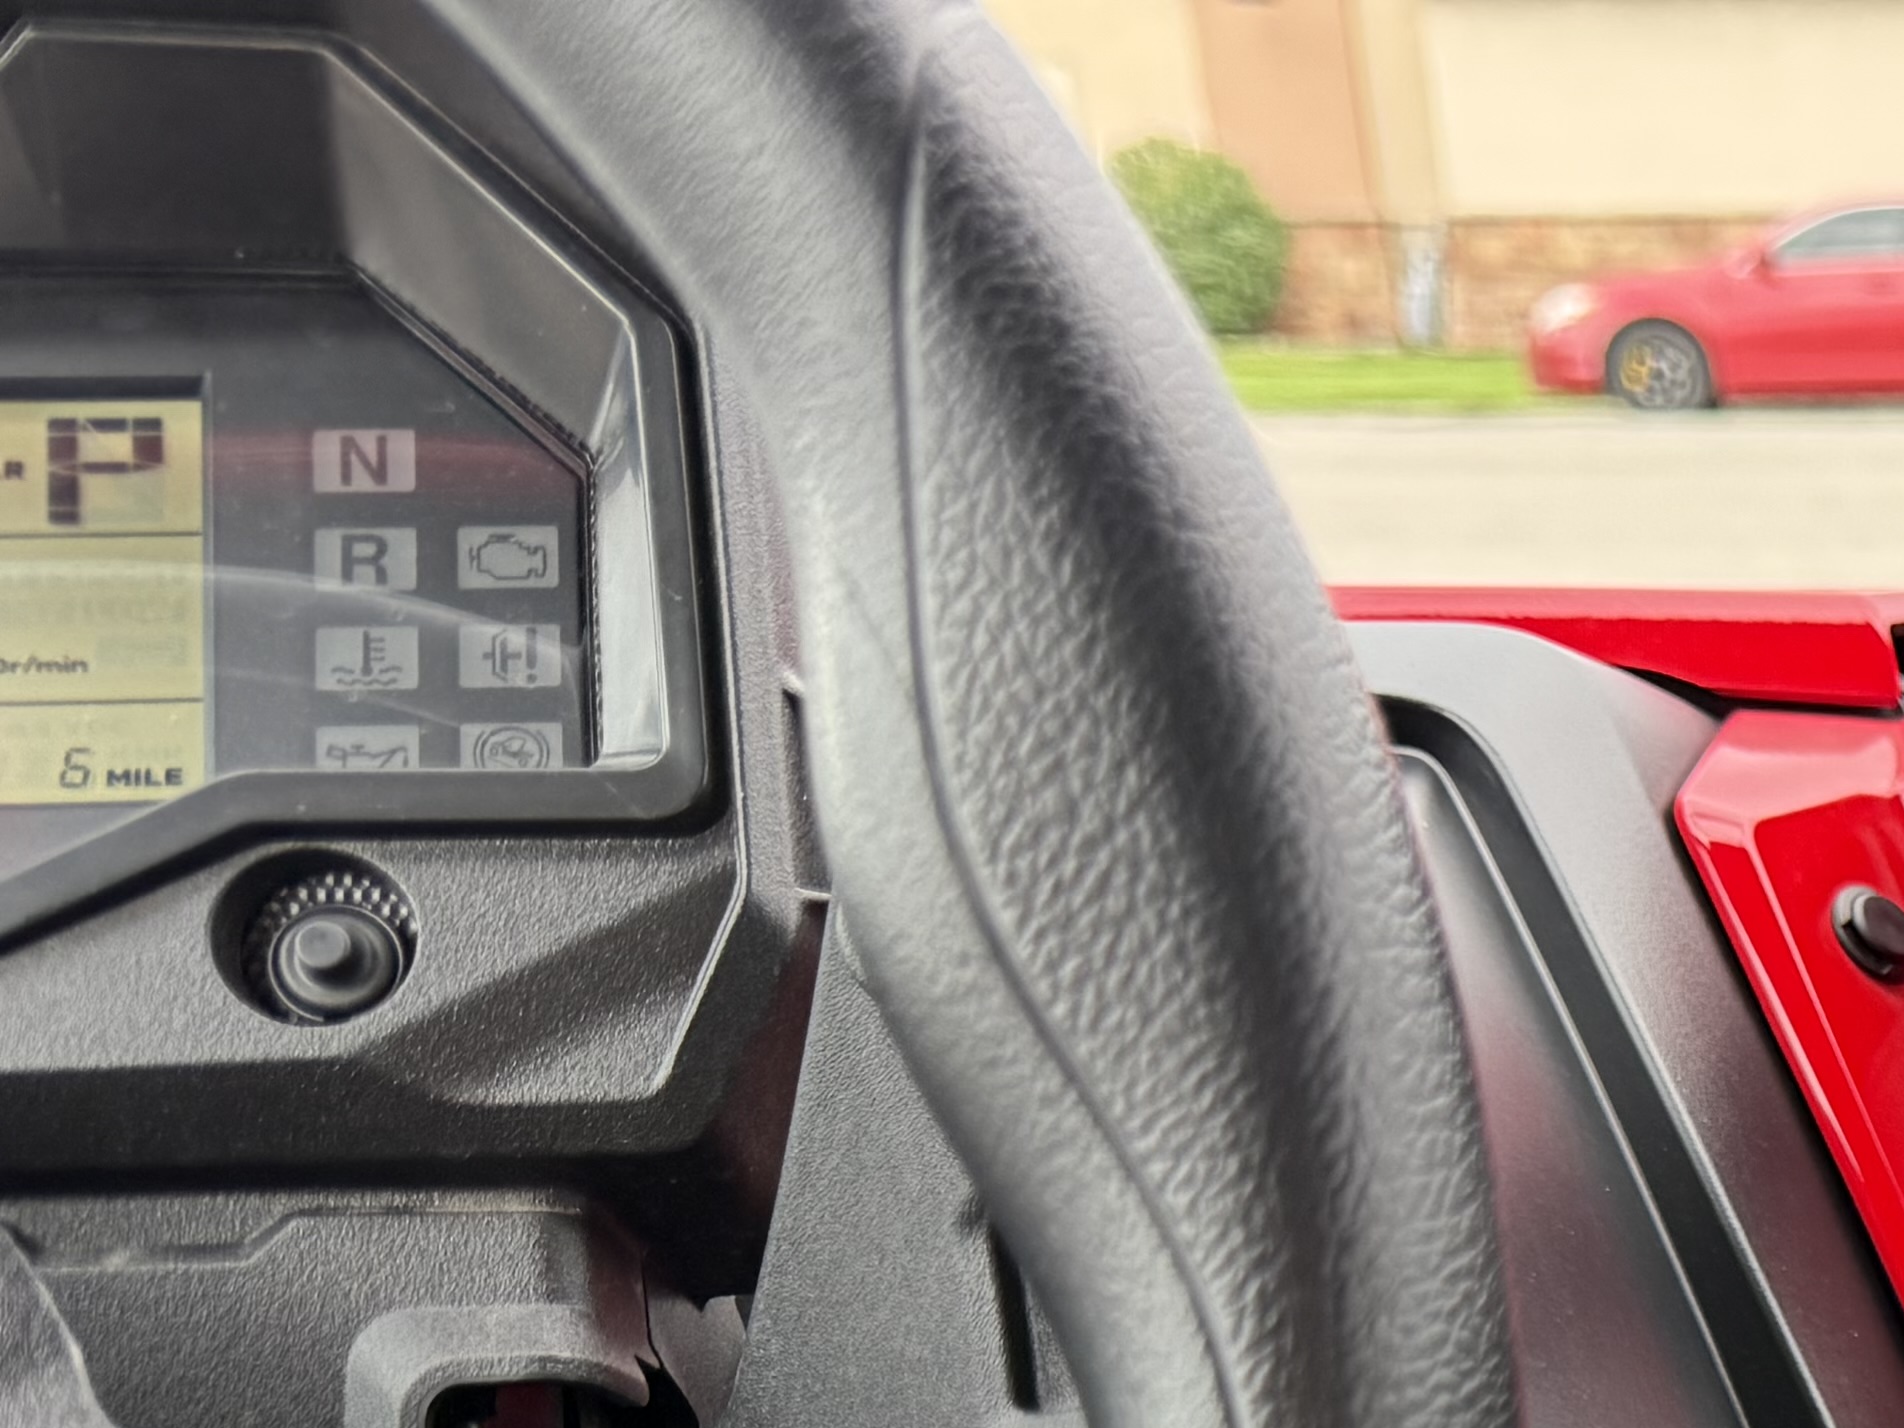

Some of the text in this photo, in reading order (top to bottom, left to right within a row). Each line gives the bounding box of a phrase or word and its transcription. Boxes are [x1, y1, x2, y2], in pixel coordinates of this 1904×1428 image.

[48, 418, 163, 524] P
[339, 435, 389, 485] N
[340, 536, 388, 585] R
[59, 748, 183, 789] 6 MILE
